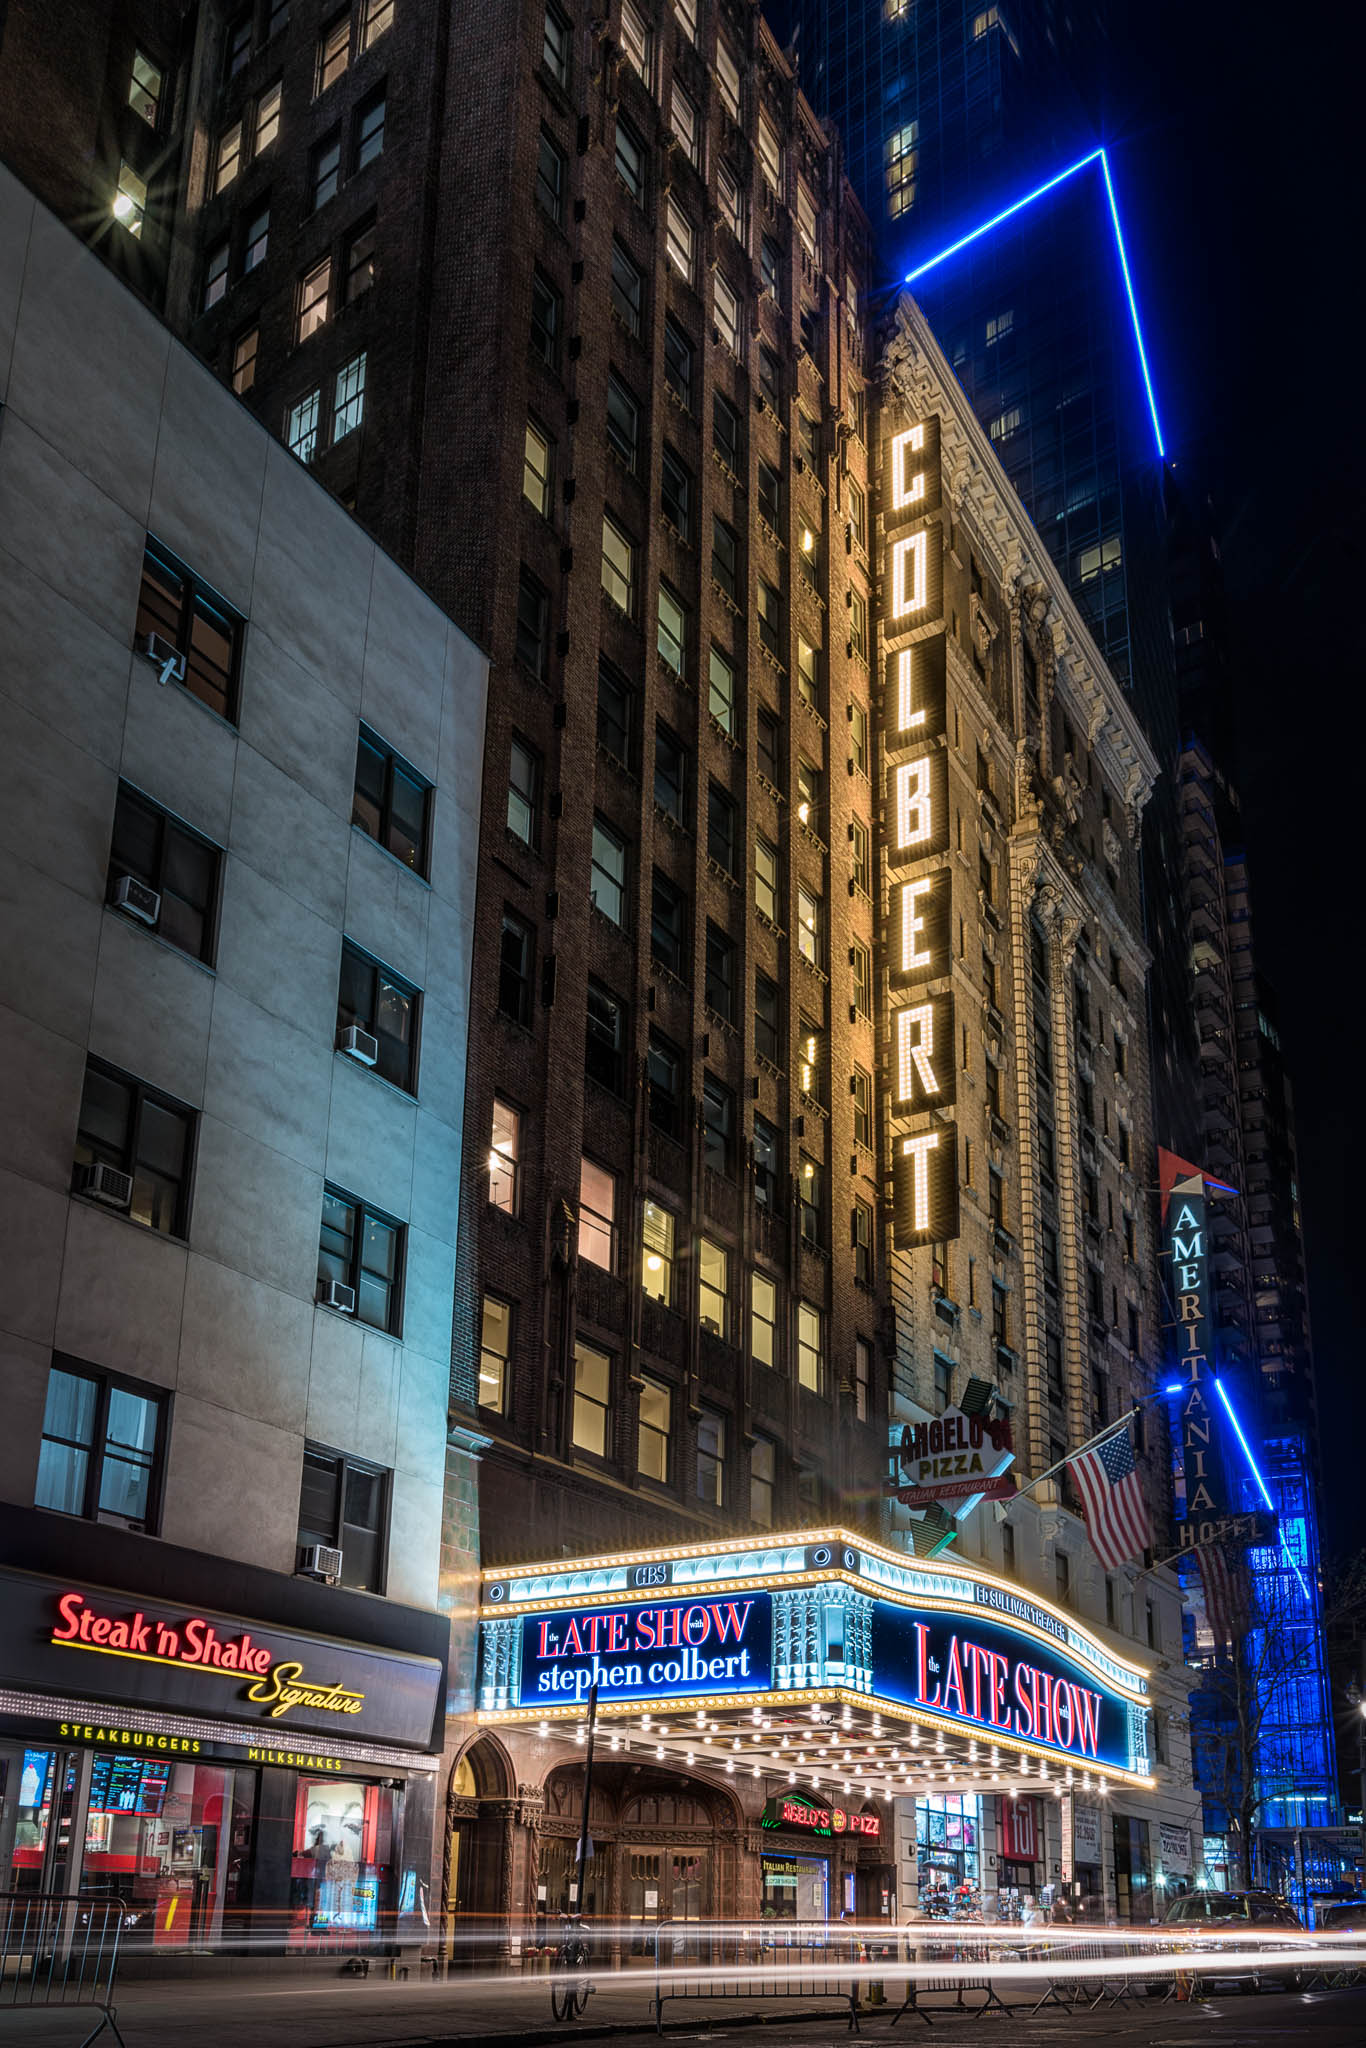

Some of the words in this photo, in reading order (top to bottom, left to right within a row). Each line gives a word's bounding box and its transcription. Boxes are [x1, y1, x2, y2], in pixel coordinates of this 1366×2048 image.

[892, 422, 939, 1232] COLBERT
[1172, 1204, 1216, 1511] AMERITANIA
[901, 1413, 1003, 1465] ANGELO'S
[918, 1453, 984, 1481] PIZZA
[901, 1487, 936, 1501] ITALIAN
[939, 1478, 1001, 1496] RESTAURANT
[1180, 1517, 1265, 1547] HOTEL
[635, 1565, 667, 1587] CBS
[536, 1613, 630, 1658] LATE
[634, 1600, 755, 1651] SHOW
[688, 1619, 705, 1629] with
[976, 1586, 990, 1604] ED
[989, 1590, 1030, 1622] SULLIVAN
[1030, 1607, 1066, 1642] THEATER
[53, 1593, 151, 1652] Steak
[181, 1619, 271, 1674] Shake
[548, 1633, 559, 1642] the
[538, 1655, 643, 1701] stephen
[648, 1647, 751, 1684] colbert
[928, 1656, 940, 1673] the
[248, 1662, 363, 1718] Signature
[913, 1622, 1012, 1730] LATE
[1015, 1662, 1103, 1758] SHOW
[1058, 1704, 1071, 1720] with
[60, 1723, 201, 1753] STEAKBURGERS
[249, 1748, 343, 1770] MILKSHAKES
[782, 1802, 830, 1828] ANGELO'S
[763, 1860, 785, 1872] ITALIAN
